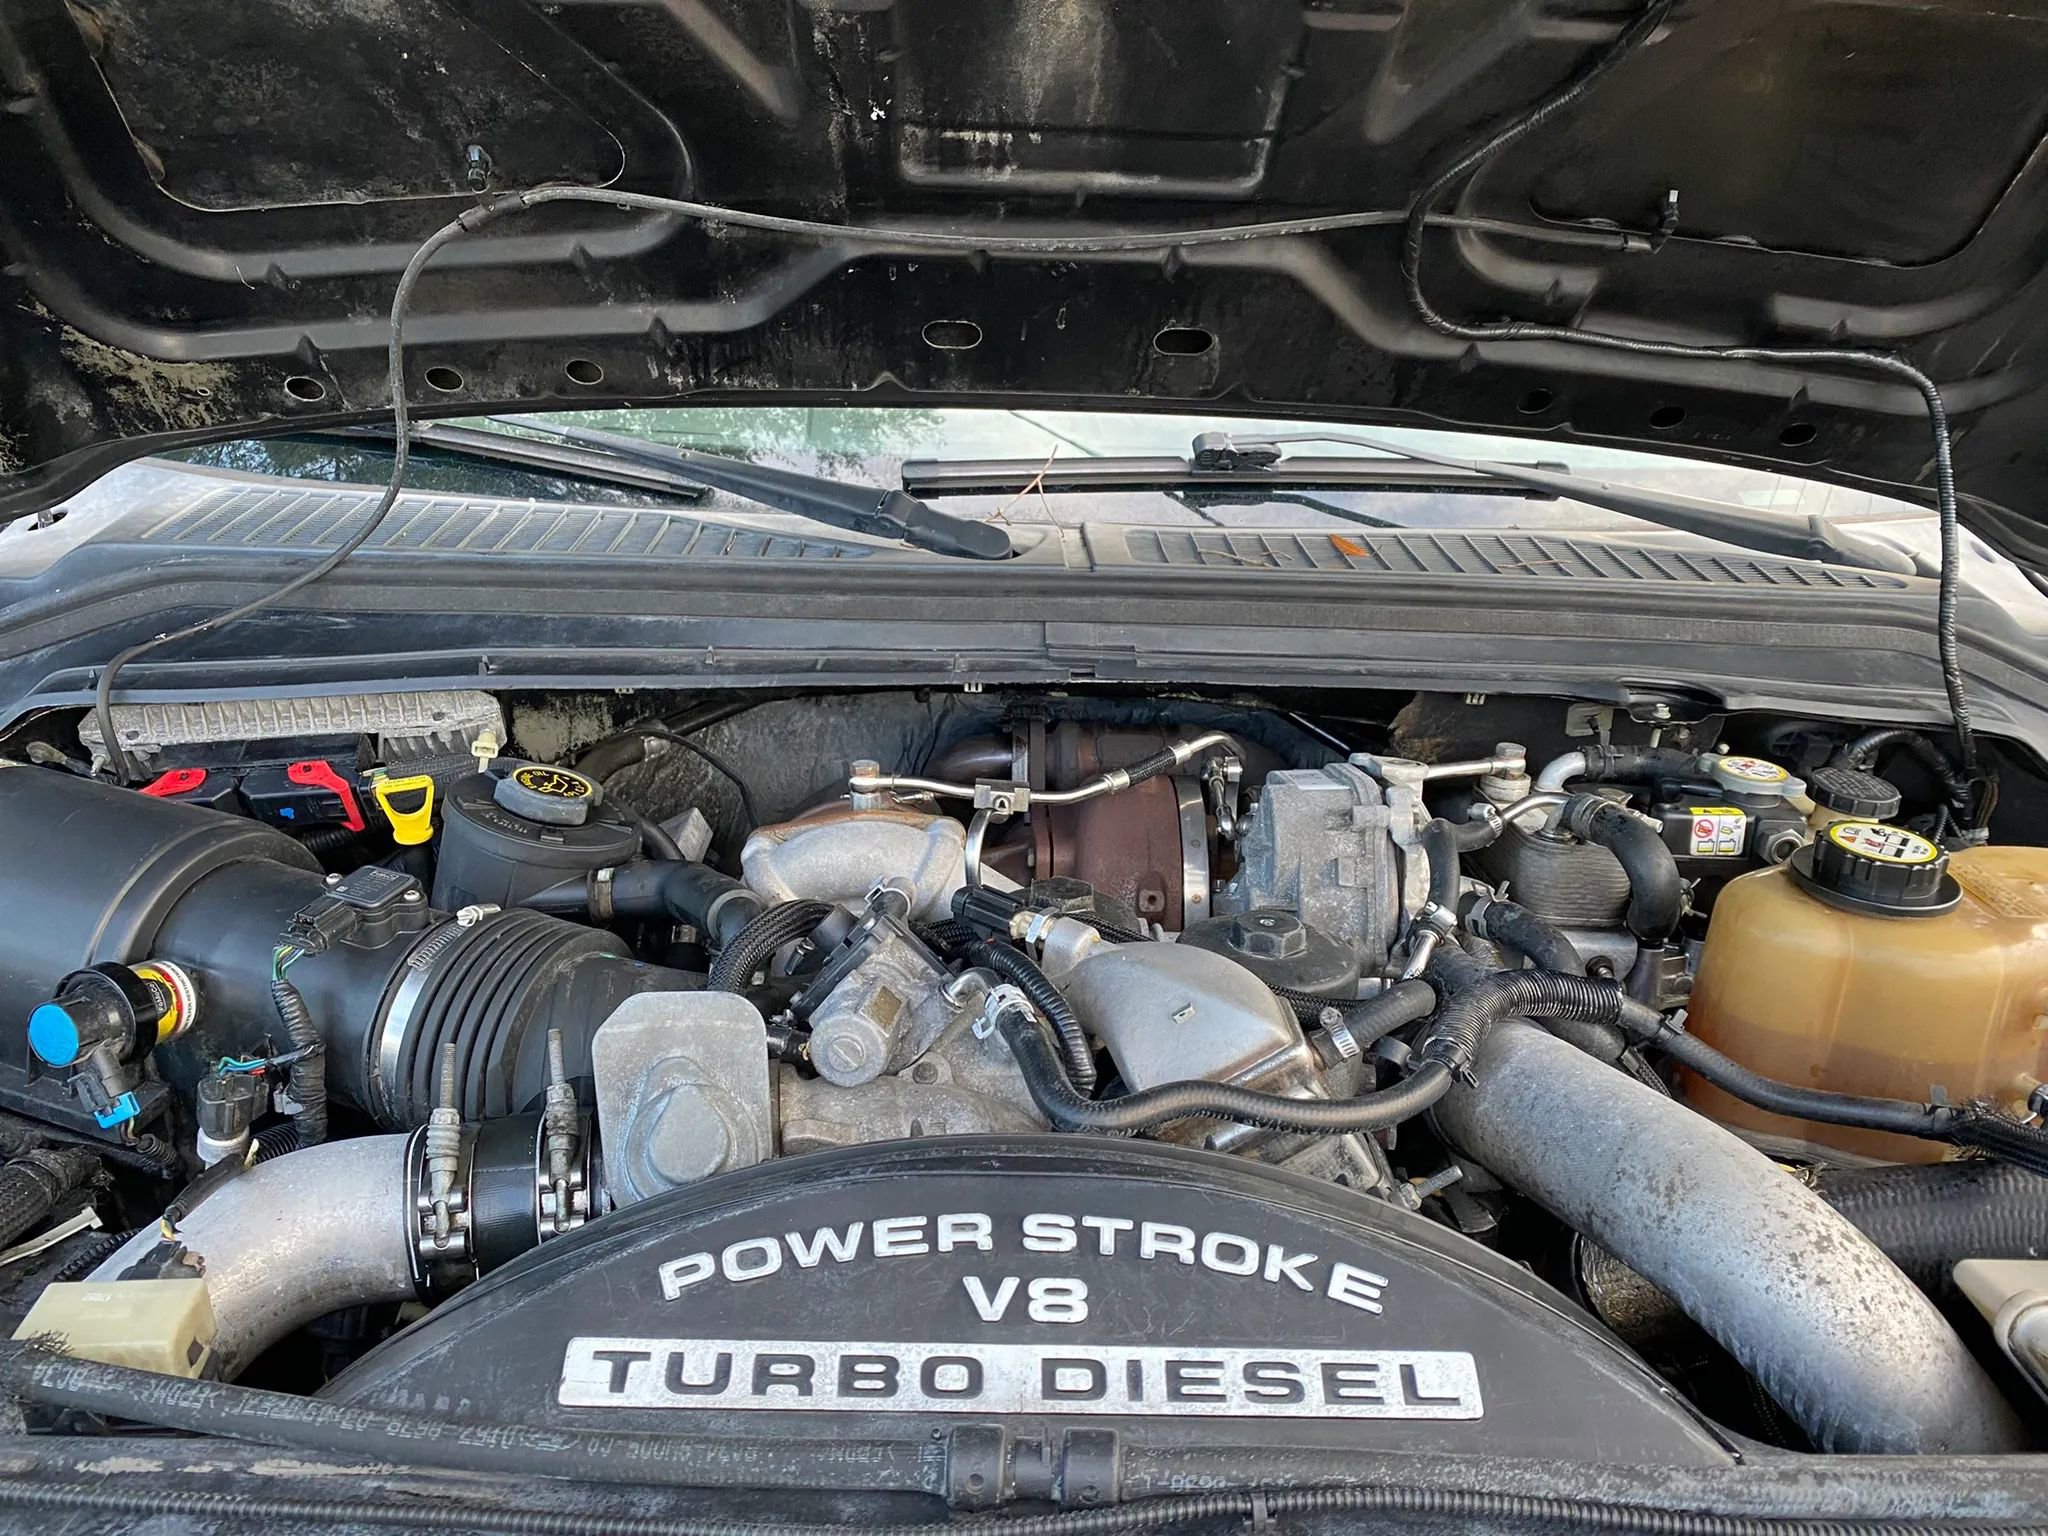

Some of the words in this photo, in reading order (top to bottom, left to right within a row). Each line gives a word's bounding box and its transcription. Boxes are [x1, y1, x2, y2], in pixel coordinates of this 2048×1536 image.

[149, 983, 164, 1012] FoMoCo
[658, 1213, 993, 1300] POWER
[1022, 1213, 1389, 1315] STROKE
[963, 1276, 1089, 1324] V8
[592, 1350, 984, 1400] TURBO
[1041, 1357, 1462, 1407] DIESEL
